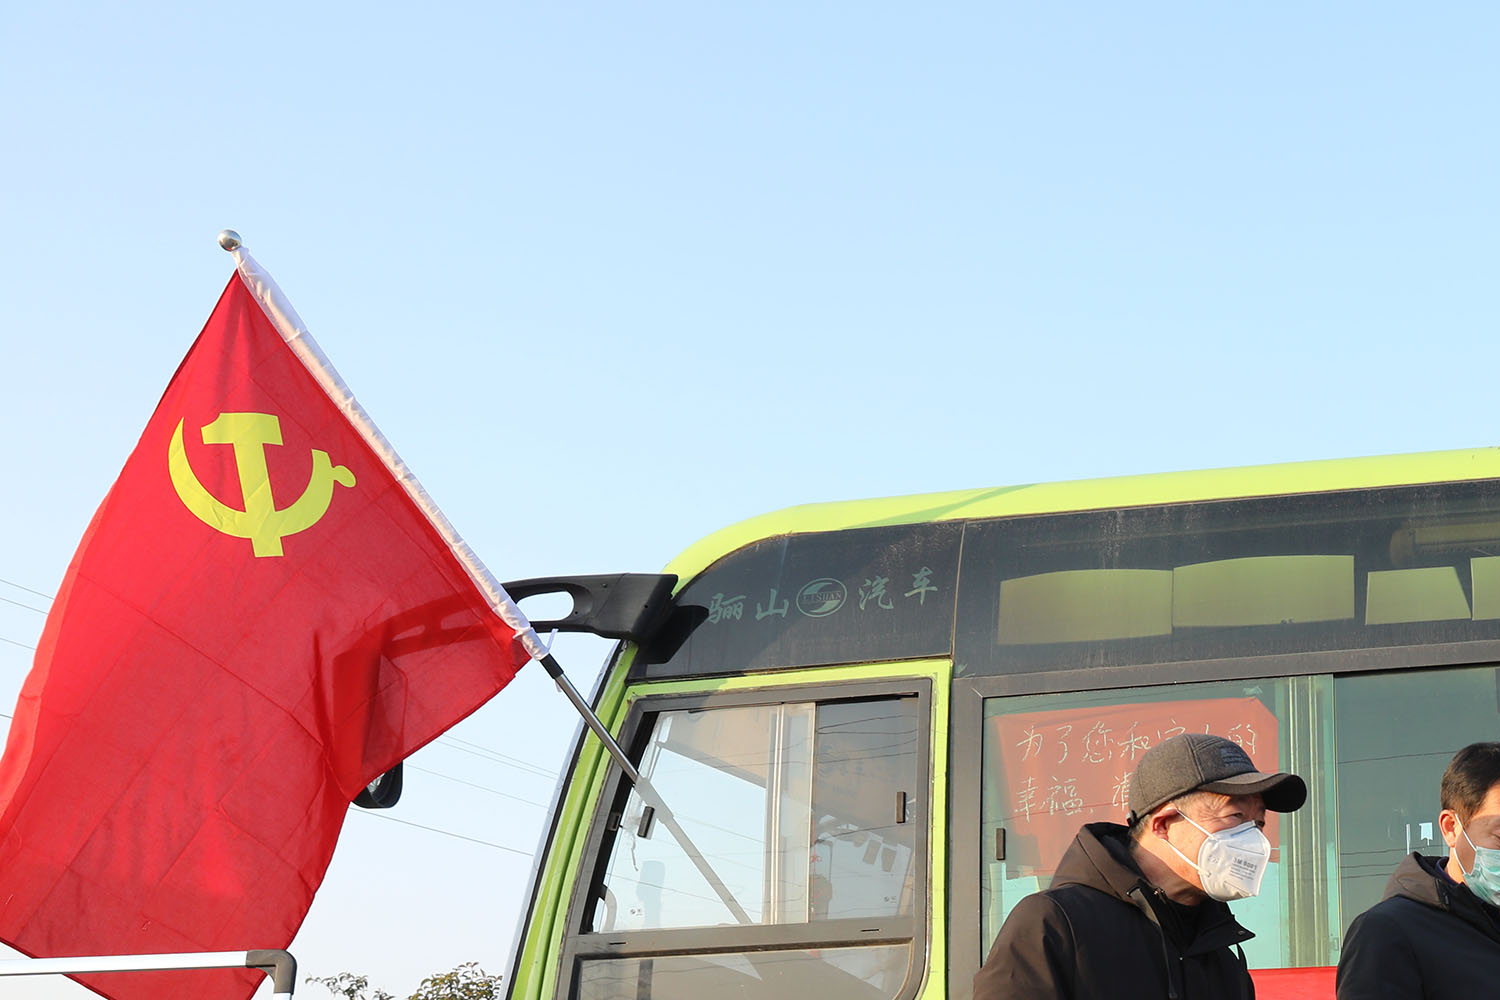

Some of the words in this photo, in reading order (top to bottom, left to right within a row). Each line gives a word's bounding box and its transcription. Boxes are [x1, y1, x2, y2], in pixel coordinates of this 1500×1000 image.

[708, 588, 789, 624] 骊山
[858, 566, 938, 611] 汽车
[1016, 718, 1256, 764] 为了您和的
